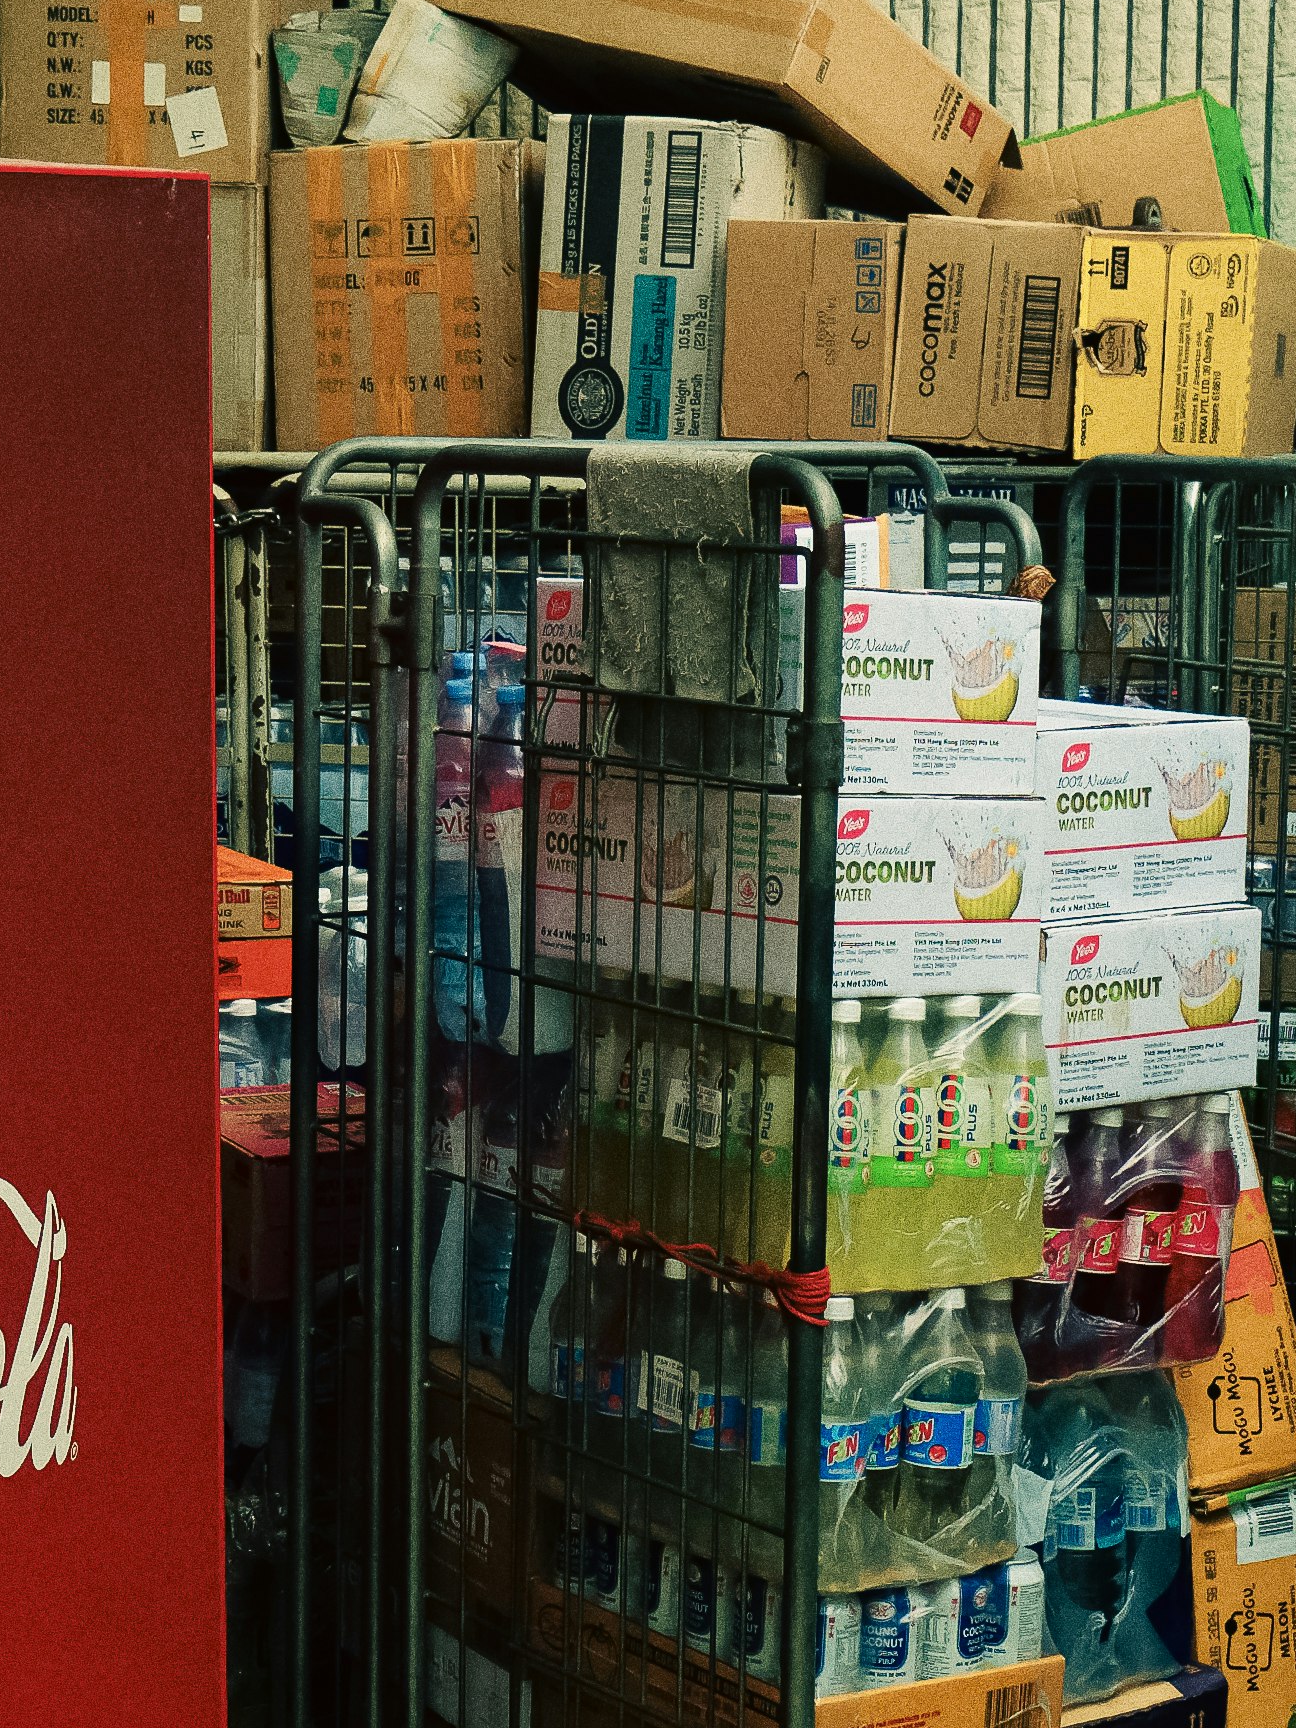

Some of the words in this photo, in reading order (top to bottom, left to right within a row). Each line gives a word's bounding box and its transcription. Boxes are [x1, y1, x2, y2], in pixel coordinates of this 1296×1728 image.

[47, 6, 98, 23] MODEL:
[47, 32, 84, 48] Q'TY:
[186, 34, 213, 50] PCS
[47, 58, 81, 73] N.W.:
[186, 60, 213, 76] KGS
[47, 109, 81, 124] SIZE:
[570, 124, 583, 161] PACKS
[569, 163, 581, 178] 20
[567, 188, 579, 227] STICKS
[1114, 250, 1126, 285] 90741
[680, 314, 694, 326] kg
[918, 262, 948, 398] cocomax
[649, 318, 668, 366] Kacang
[678, 328, 690, 350] 10.5
[635, 373, 652, 432] Hazelnut
[675, 379, 690, 415] Weight
[690, 374, 703, 405] Bersih
[674, 417, 684, 435] Net
[688, 408, 701, 436] Berat
[862, 639, 910, 653] Natural
[1057, 776, 1082, 789] 100%
[1084, 772, 1129, 789] Natural
[1056, 787, 1152, 815] COCONUT
[1059, 817, 1095, 832] WATER
[862, 841, 911, 857] Natural
[835, 860, 936, 884] COCONUT
[225, 889, 250, 903] Bull
[1073, 903, 1086, 911] Net
[846, 980, 860, 988] Net
[1065, 967, 1093, 982] 100%
[1095, 961, 1139, 980] Natural
[1065, 976, 1162, 1007] COCONUT
[1067, 1008, 1104, 1024] WATER
[638, 1068, 651, 1104] PLUS
[761, 1102, 773, 1140] PLUS
[967, 1104, 977, 1142] PLUS
[1040, 1103, 1048, 1140] PLUS
[1223, 1352, 1240, 1401] MOGU
[1263, 1366, 1283, 1421] LYCHEE
[1233, 1407, 1253, 1455] MOGU
[827, 1431, 860, 1466] F&N
[1243, 1587, 1257, 1636] MOGU
[1278, 1602, 1291, 1658] MELON
[1245, 1642, 1260, 1691] MOGU
